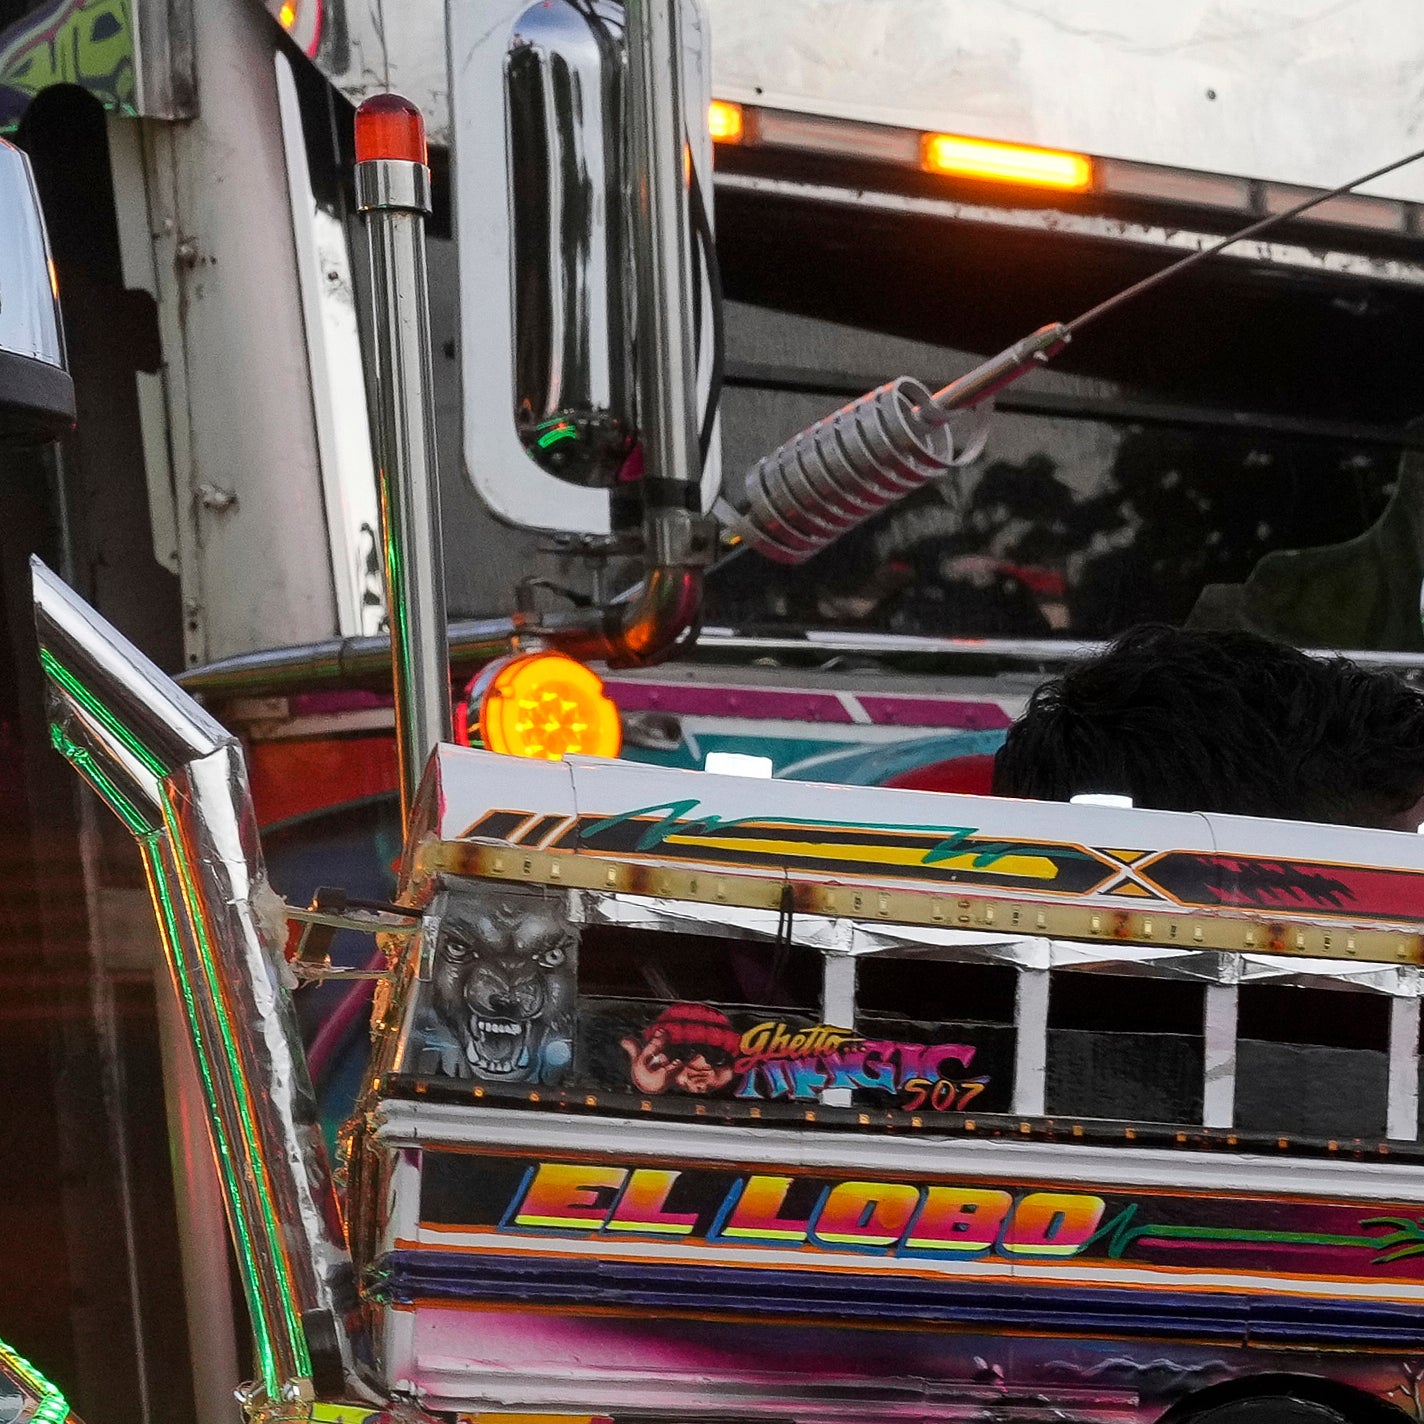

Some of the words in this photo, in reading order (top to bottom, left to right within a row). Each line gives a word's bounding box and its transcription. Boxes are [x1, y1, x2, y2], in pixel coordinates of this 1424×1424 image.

[902, 1078, 986, 1111] 507
[509, 1162, 699, 1236] EL
[716, 1175, 1107, 1257] LOBO
